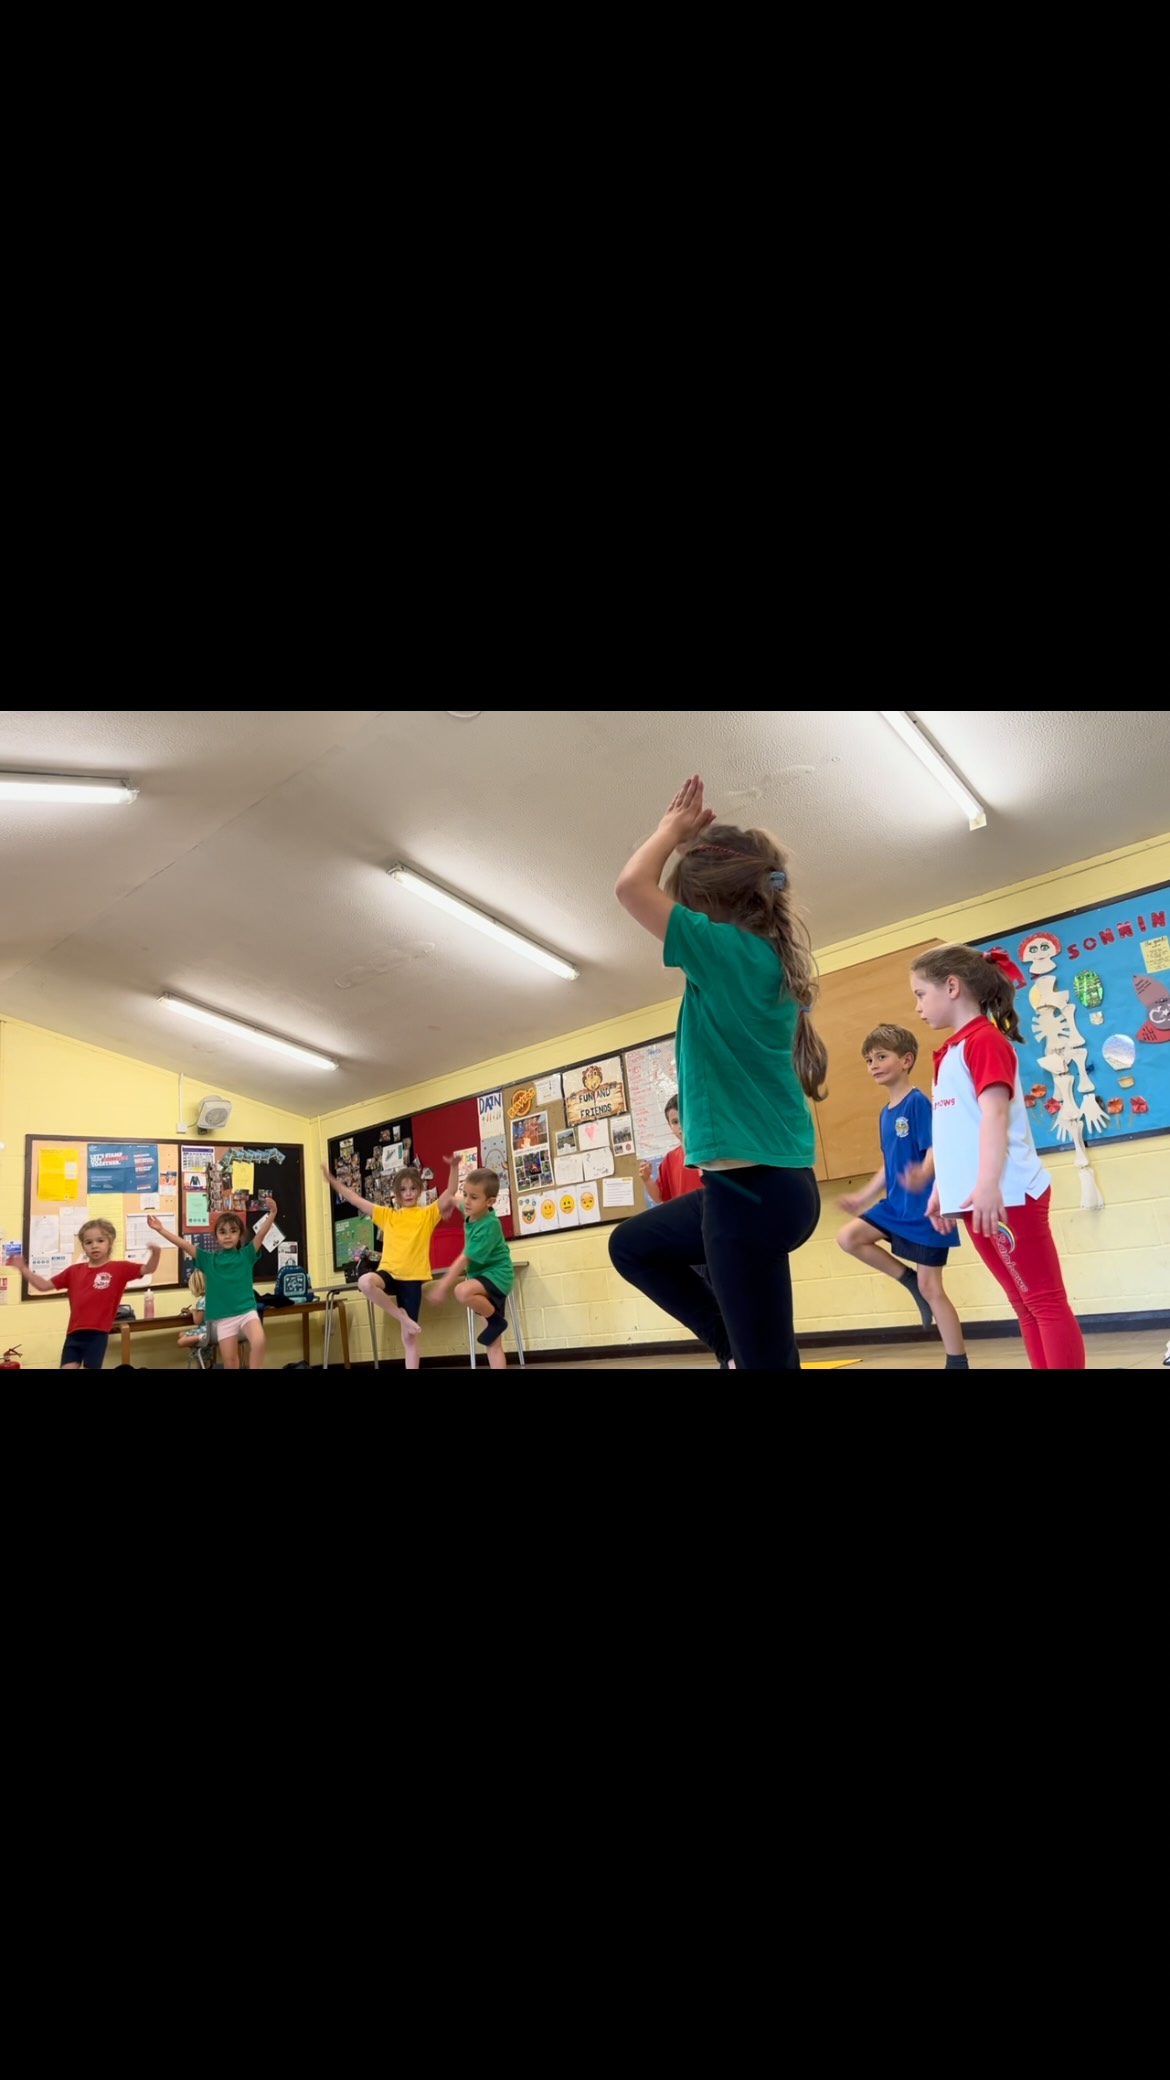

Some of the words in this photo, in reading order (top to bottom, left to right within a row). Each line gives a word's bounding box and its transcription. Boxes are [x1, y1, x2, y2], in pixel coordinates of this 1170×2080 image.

[579, 1093, 594, 1103] FUN
[597, 1087, 611, 1099] AND
[580, 1103, 612, 1118] FRIENDS
